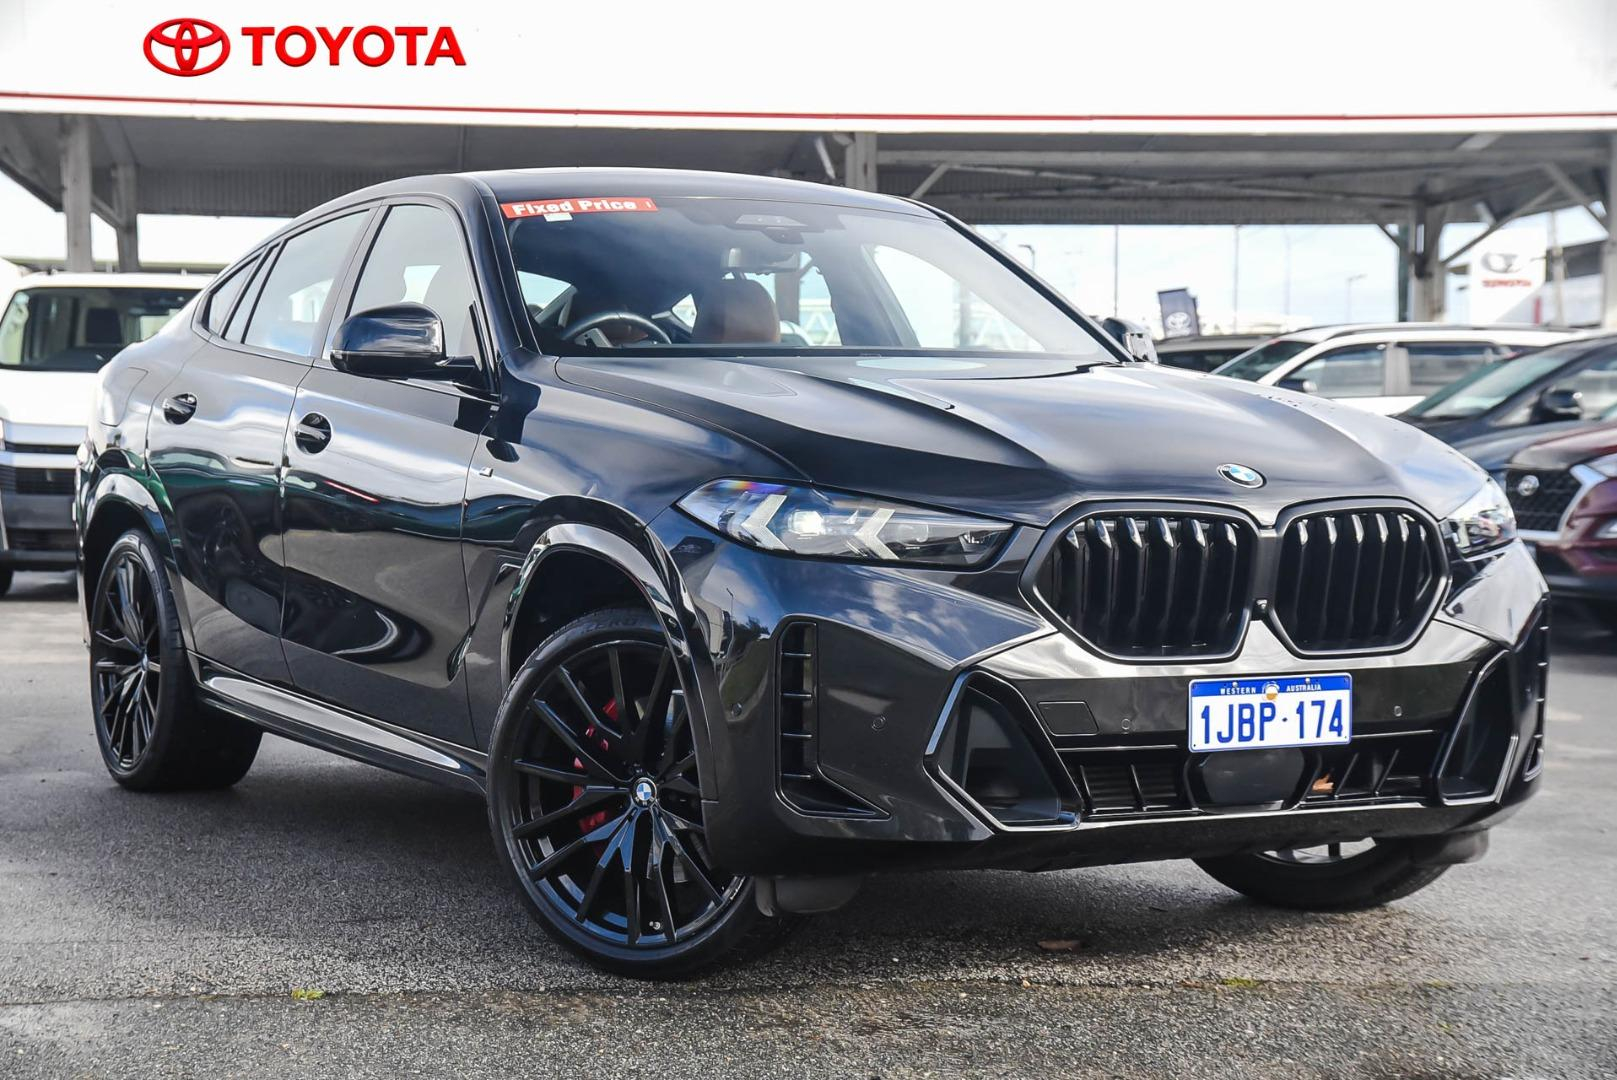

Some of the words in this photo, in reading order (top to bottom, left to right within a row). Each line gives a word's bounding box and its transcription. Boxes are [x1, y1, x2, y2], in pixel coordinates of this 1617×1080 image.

[241, 25, 467, 67] TOYOTA
[511, 201, 574, 216] Fixed
[577, 199, 637, 211] Price
[1220, 687, 1256, 695] WESTERN
[1286, 684, 1321, 692] AUSTRALIA
